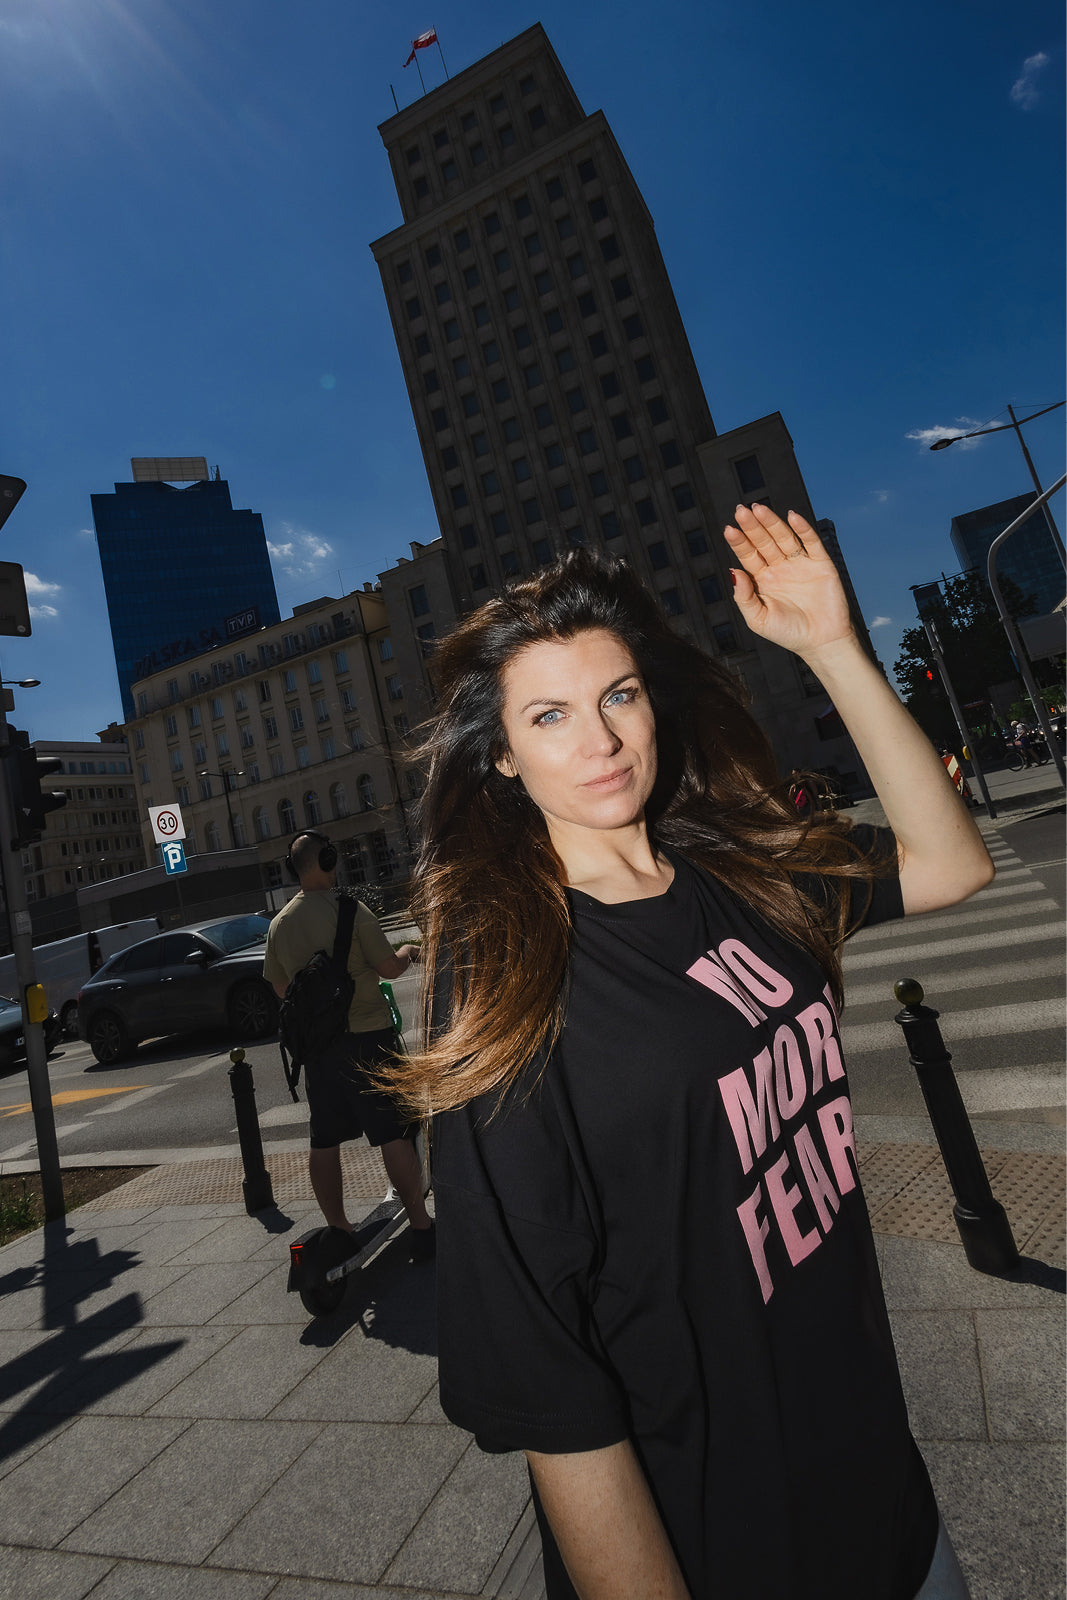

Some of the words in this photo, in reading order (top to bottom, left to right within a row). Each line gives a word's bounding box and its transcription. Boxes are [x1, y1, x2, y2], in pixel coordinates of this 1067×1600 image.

[228, 612, 255, 632] TVP
[159, 816, 175, 830] 30
[167, 848, 182, 870] P
[685, 938, 794, 1028] NO
[736, 1095, 859, 1305] FEAR
